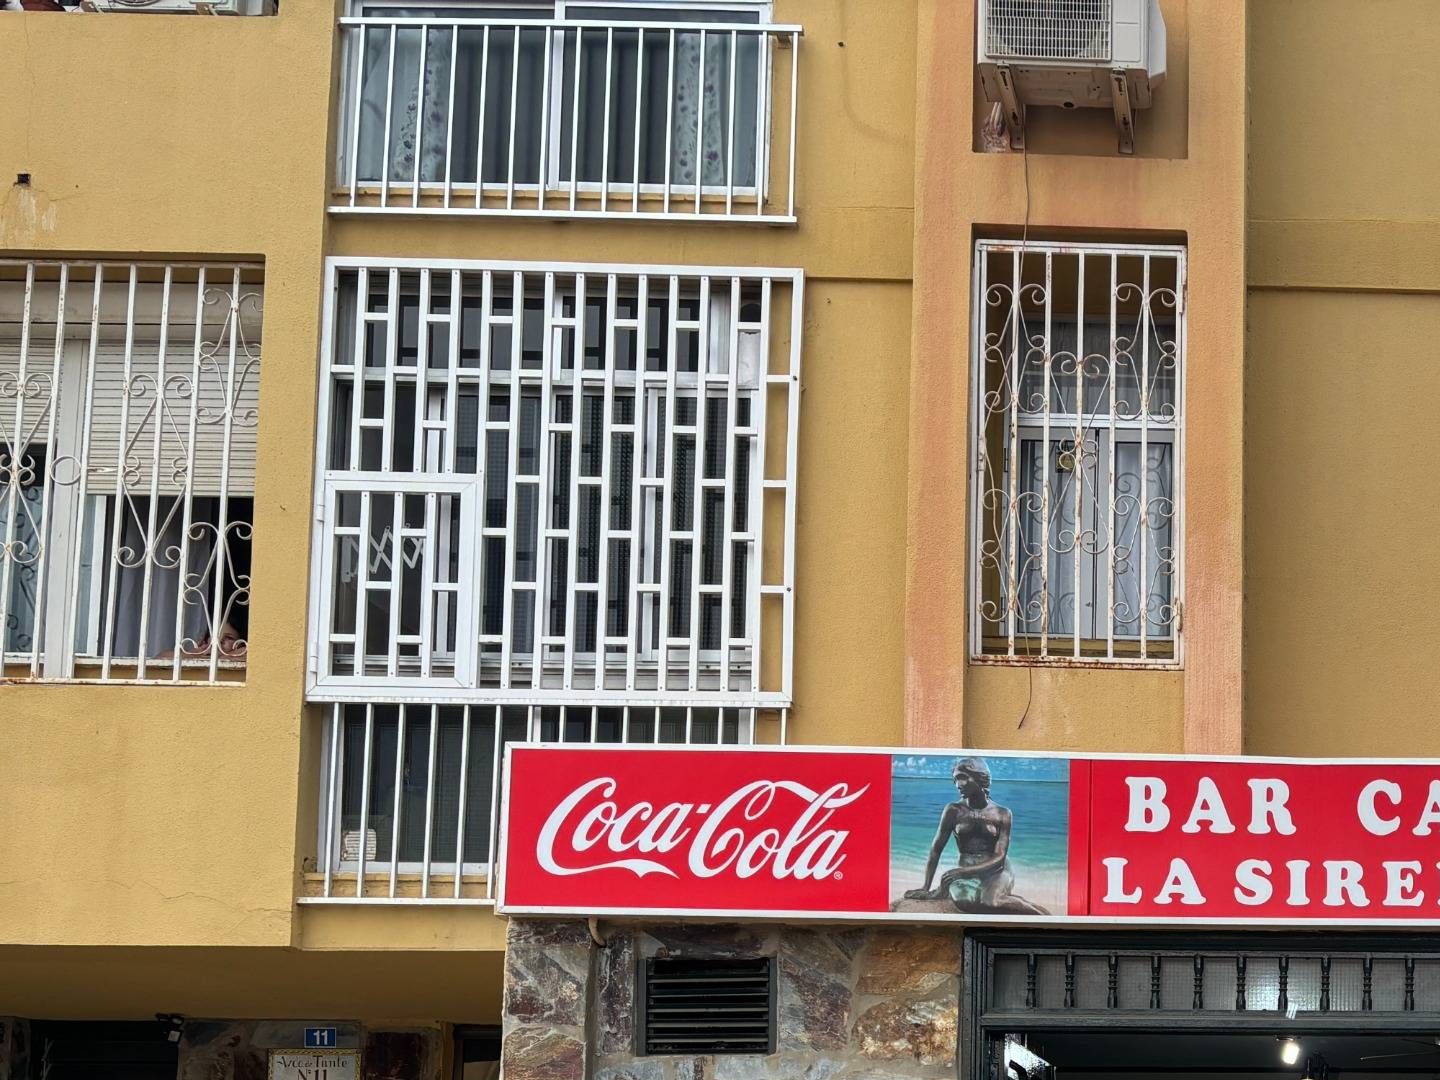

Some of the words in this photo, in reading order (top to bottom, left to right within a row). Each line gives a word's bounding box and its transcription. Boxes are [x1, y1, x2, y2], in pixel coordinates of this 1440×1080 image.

[536, 776, 870, 880] Coca-Cola
[1124, 776, 1297, 836] BAR
[1102, 856, 1207, 905] LA
[313, 1029, 329, 1046] 11
